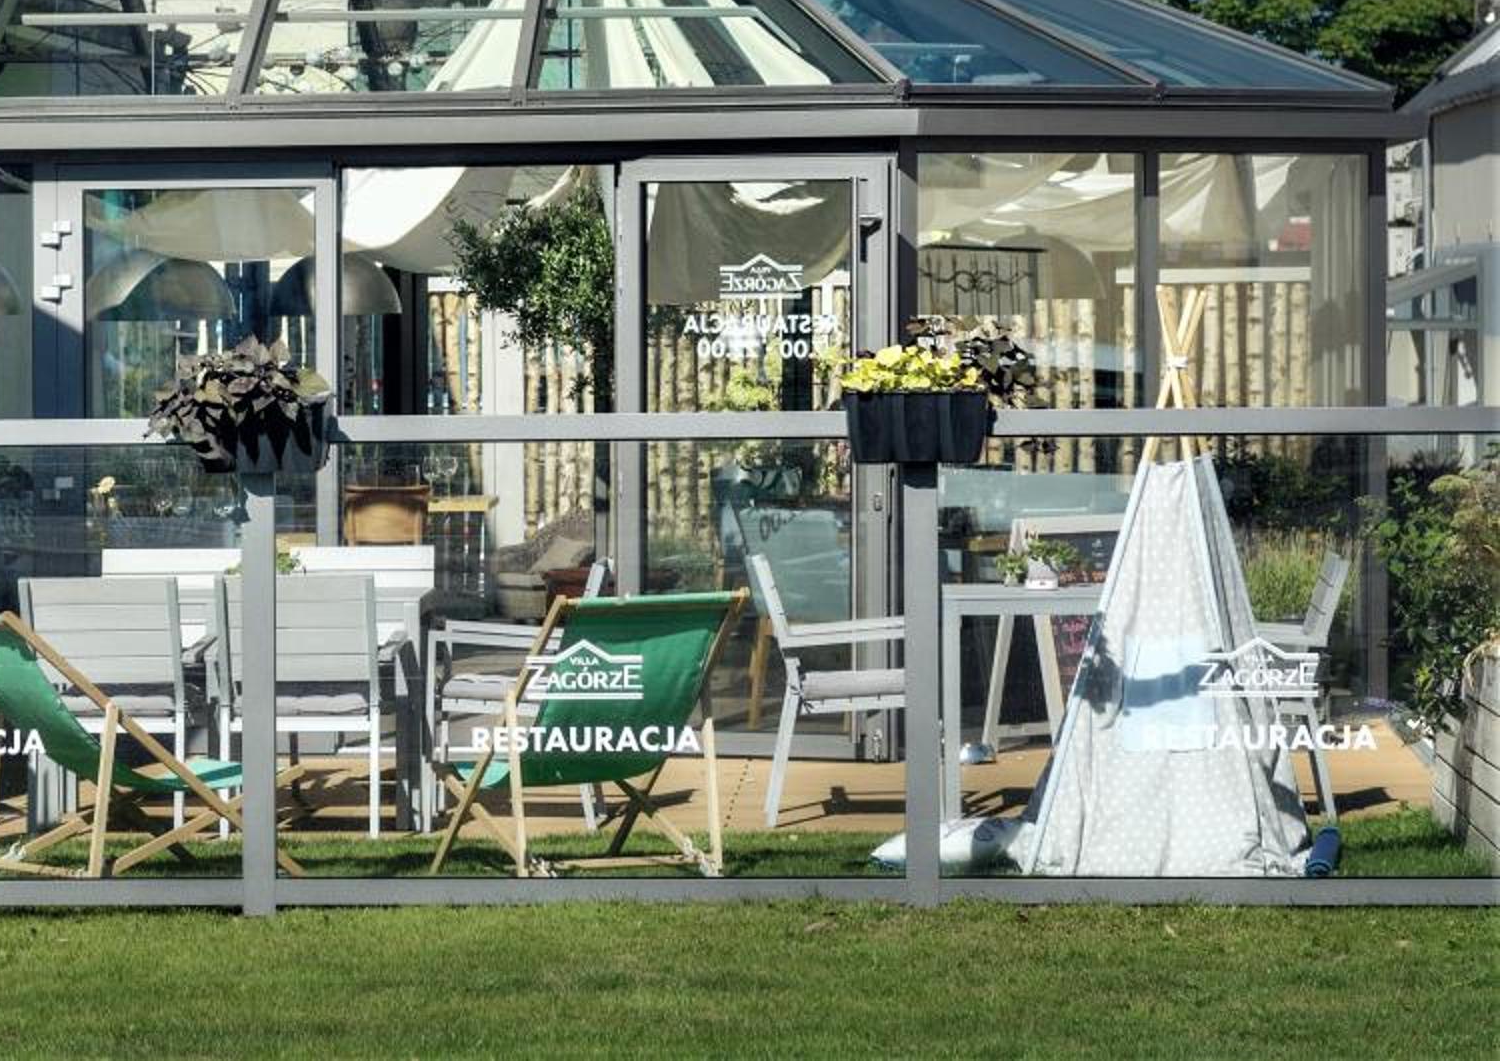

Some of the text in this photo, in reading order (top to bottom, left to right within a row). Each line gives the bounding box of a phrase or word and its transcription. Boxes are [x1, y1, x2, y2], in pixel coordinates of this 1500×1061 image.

[569, 656, 600, 666] VILLA
[525, 664, 644, 690] ZAGÓRZE
[471, 725, 701, 753] RESTAURACJA
